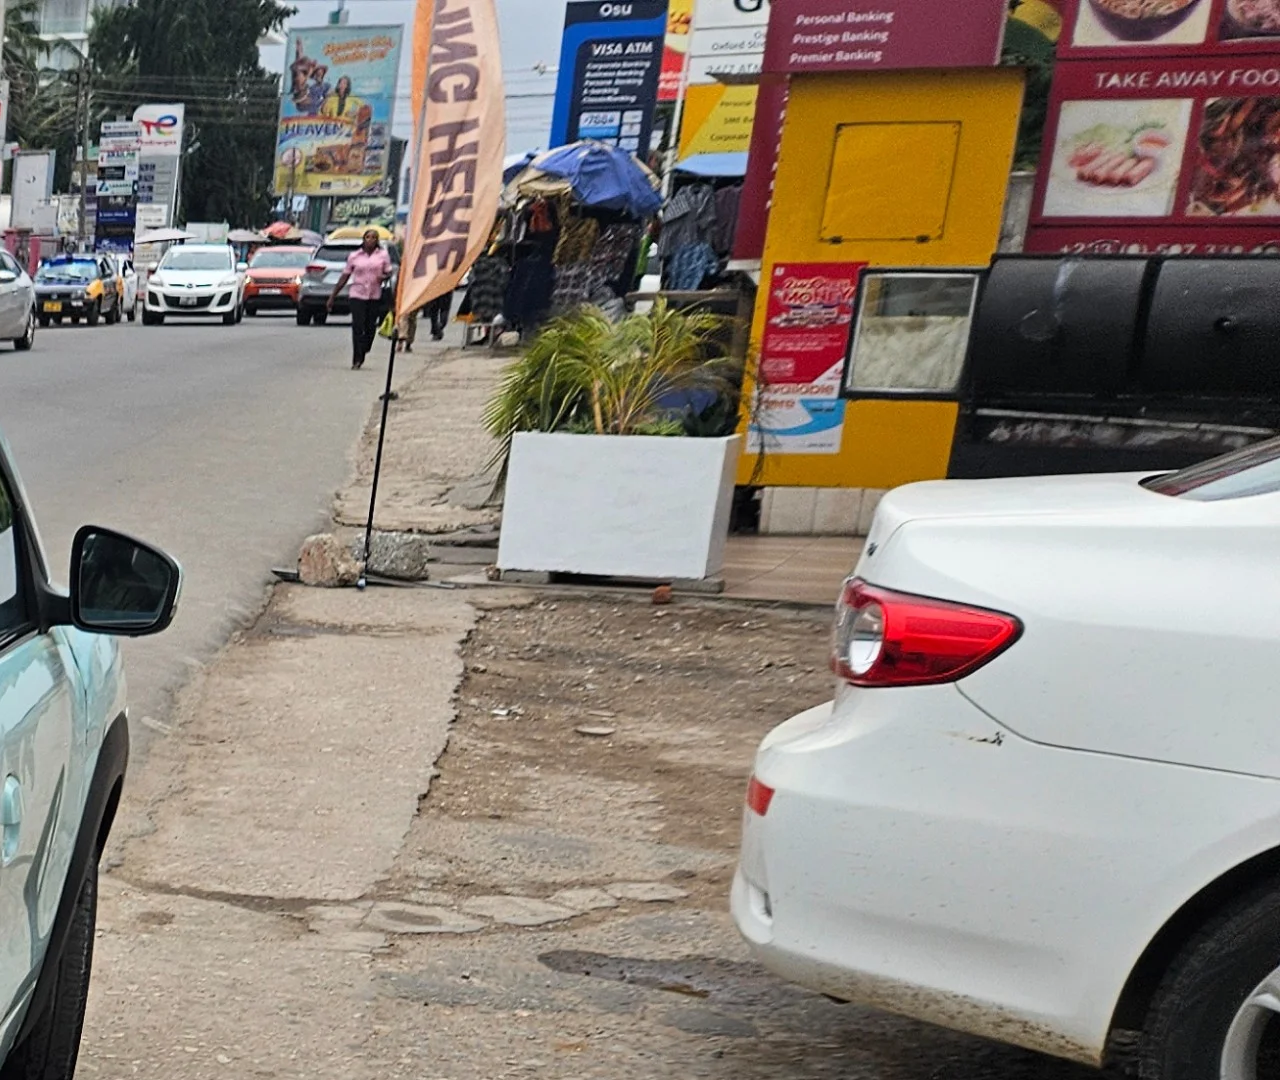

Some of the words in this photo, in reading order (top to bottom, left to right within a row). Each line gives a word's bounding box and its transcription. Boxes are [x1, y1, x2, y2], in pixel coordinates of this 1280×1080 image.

[599, 3, 633, 16] Osu
[794, 11, 845, 26] Personal
[846, 10, 895, 24] Banking
[791, 32, 840, 46] Prestige
[841, 30, 890, 44] Banking
[429, 0, 478, 104] ING
[591, 43, 623, 55] VISA
[625, 41, 654, 54] ATM
[788, 52, 835, 65] Premier
[835, 50, 883, 64] Banking
[1095, 71, 1152, 88] TAKE
[1154, 70, 1225, 87] AWAY
[1228, 68, 1280, 86] FOO
[412, 117, 481, 280] HERE
